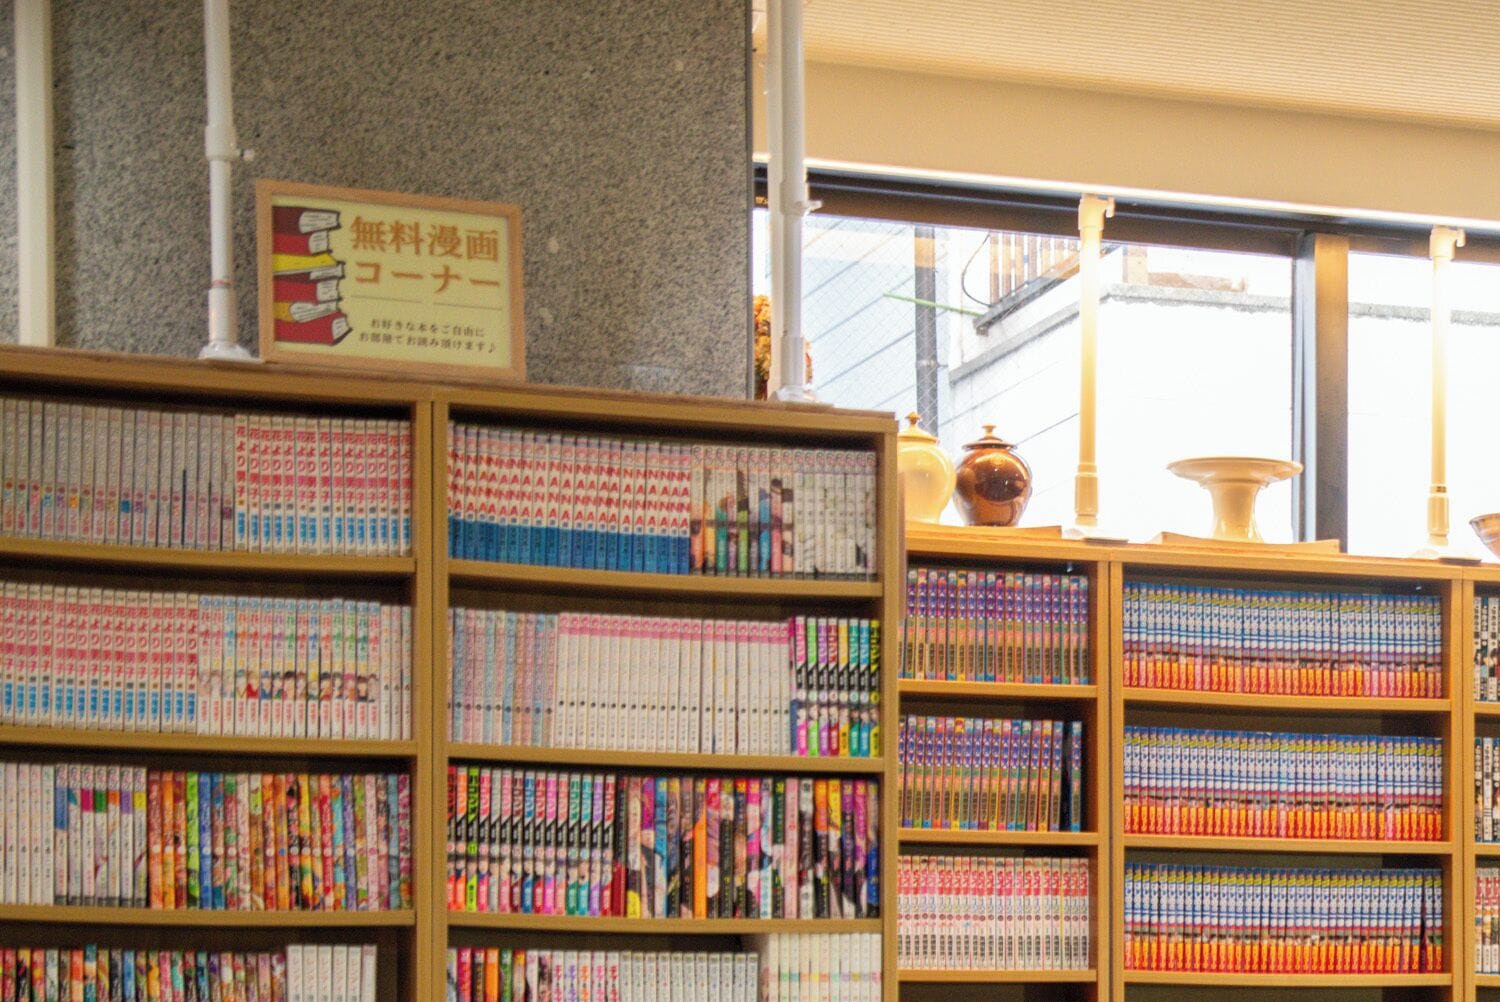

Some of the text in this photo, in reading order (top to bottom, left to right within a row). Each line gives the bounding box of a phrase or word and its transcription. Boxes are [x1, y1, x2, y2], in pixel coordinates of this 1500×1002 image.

[350, 215, 500, 263] 無料漫画
[354, 261, 500, 294] コーナー
[371, 318, 486, 338] お好きな本をご自由に
[236, 426, 246, 497] 花より男子
[251, 429, 259, 497] 花より男子
[261, 430, 271, 500] 花より男子
[272, 430, 282, 500] 花より男子
[284, 431, 294, 500] 花より男子
[298, 432, 306, 501] 花より男子
[307, 432, 316, 503] 花より男子
[320, 432, 330, 503] 花より男子
[333, 432, 343, 502] 花より男子
[345, 433, 355, 502] 花より男子
[356, 434, 365, 503] 花より男子
[368, 434, 377, 503] 花より男子
[378, 434, 388, 504] 花より男子
[390, 435, 399, 505] 花より男子
[401, 434, 411, 504] 花より男子
[454, 452, 465, 511] NANA
[466, 454, 476, 512] NANA
[478, 455, 488, 513] NANA
[488, 456, 498, 514] NANA
[500, 458, 510, 516] NANA
[510, 458, 521, 515] NANA
[522, 459, 532, 516] NANA
[535, 460, 546, 517] NANA
[549, 461, 560, 518] NANA
[562, 462, 573, 521] NANA
[575, 463, 586, 521] NANA
[586, 464, 597, 522] NANA
[599, 466, 610, 522] NANA
[609, 466, 619, 523] NANA
[623, 468, 633, 525] NANA
[636, 469, 646, 525] NANA
[648, 470, 658, 525] NANA
[660, 471, 670, 527] NANA
[671, 471, 681, 527] NANA
[681, 471, 691, 528] NANA
[5, 598, 16, 672] 花より男子
[17, 599, 27, 672] 花より男子
[29, 600, 39, 672] 花より男子
[42, 600, 52, 672] 花より男子
[56, 602, 65, 675] 花より男子
[68, 603, 77, 674] 花より男子
[79, 604, 89, 677] 花より男子
[91, 604, 100, 676] 花より男子
[103, 605, 113, 677] 花より男子
[115, 606, 125, 678] 花より男子
[128, 606, 137, 678] 花より男子
[139, 607, 149, 678] 花より男子
[152, 608, 161, 678] 花より男子
[164, 608, 173, 678] 花より男子
[176, 608, 185, 678] 花より男子
[188, 608, 198, 680] 花より男子
